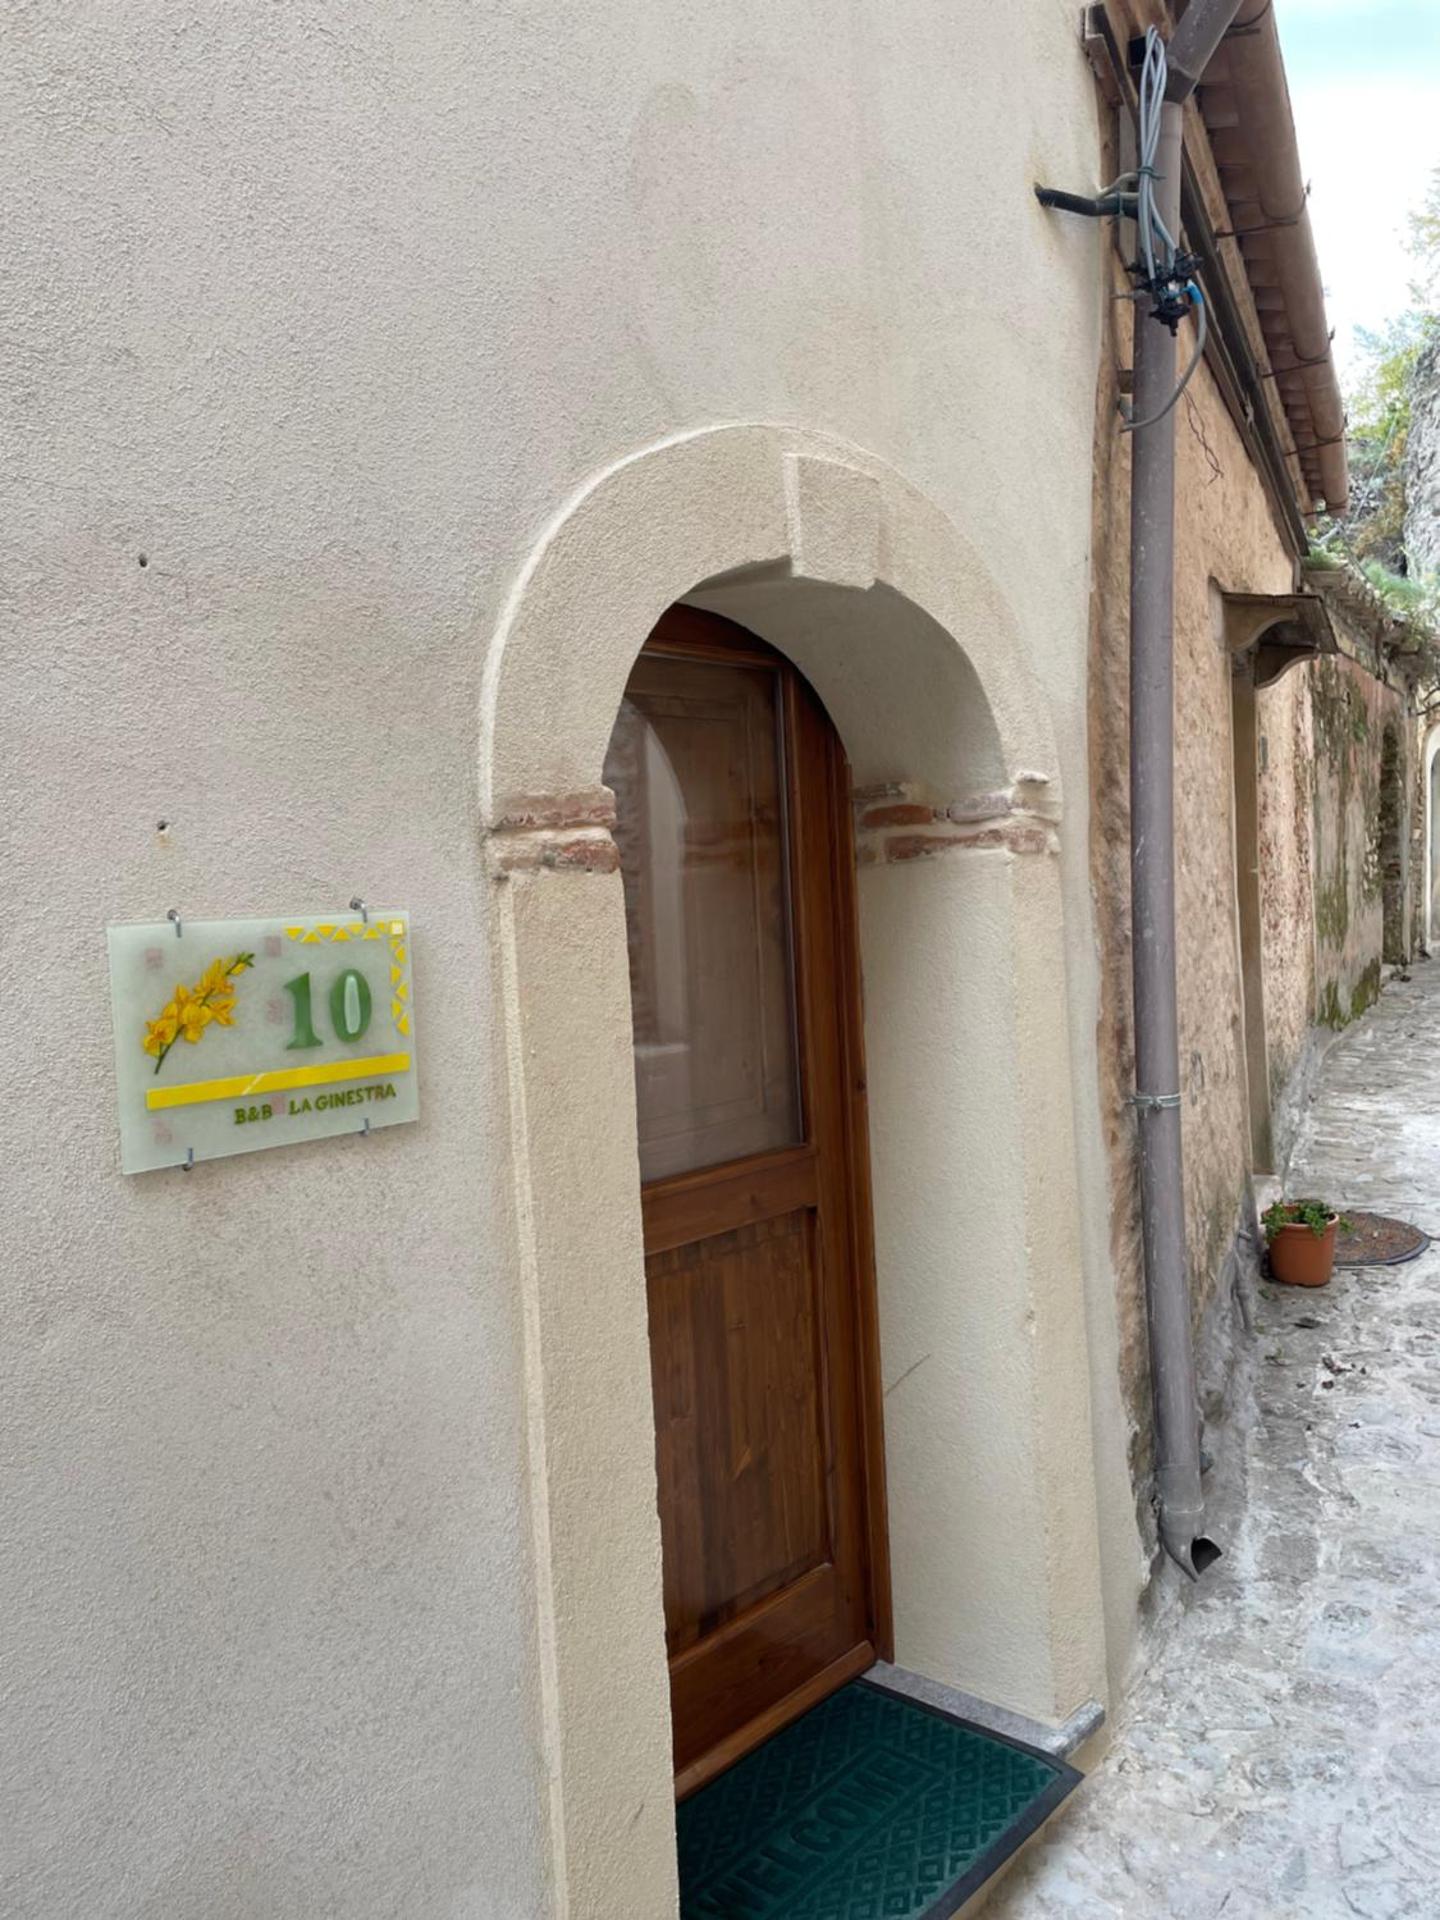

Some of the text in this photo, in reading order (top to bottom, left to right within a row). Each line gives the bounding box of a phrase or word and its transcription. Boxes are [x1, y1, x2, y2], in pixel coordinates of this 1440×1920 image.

[283, 968, 372, 1050] 10
[234, 1083, 396, 1125] B&B LA GINESTRA
[696, 1753, 928, 1918] WELCOME
